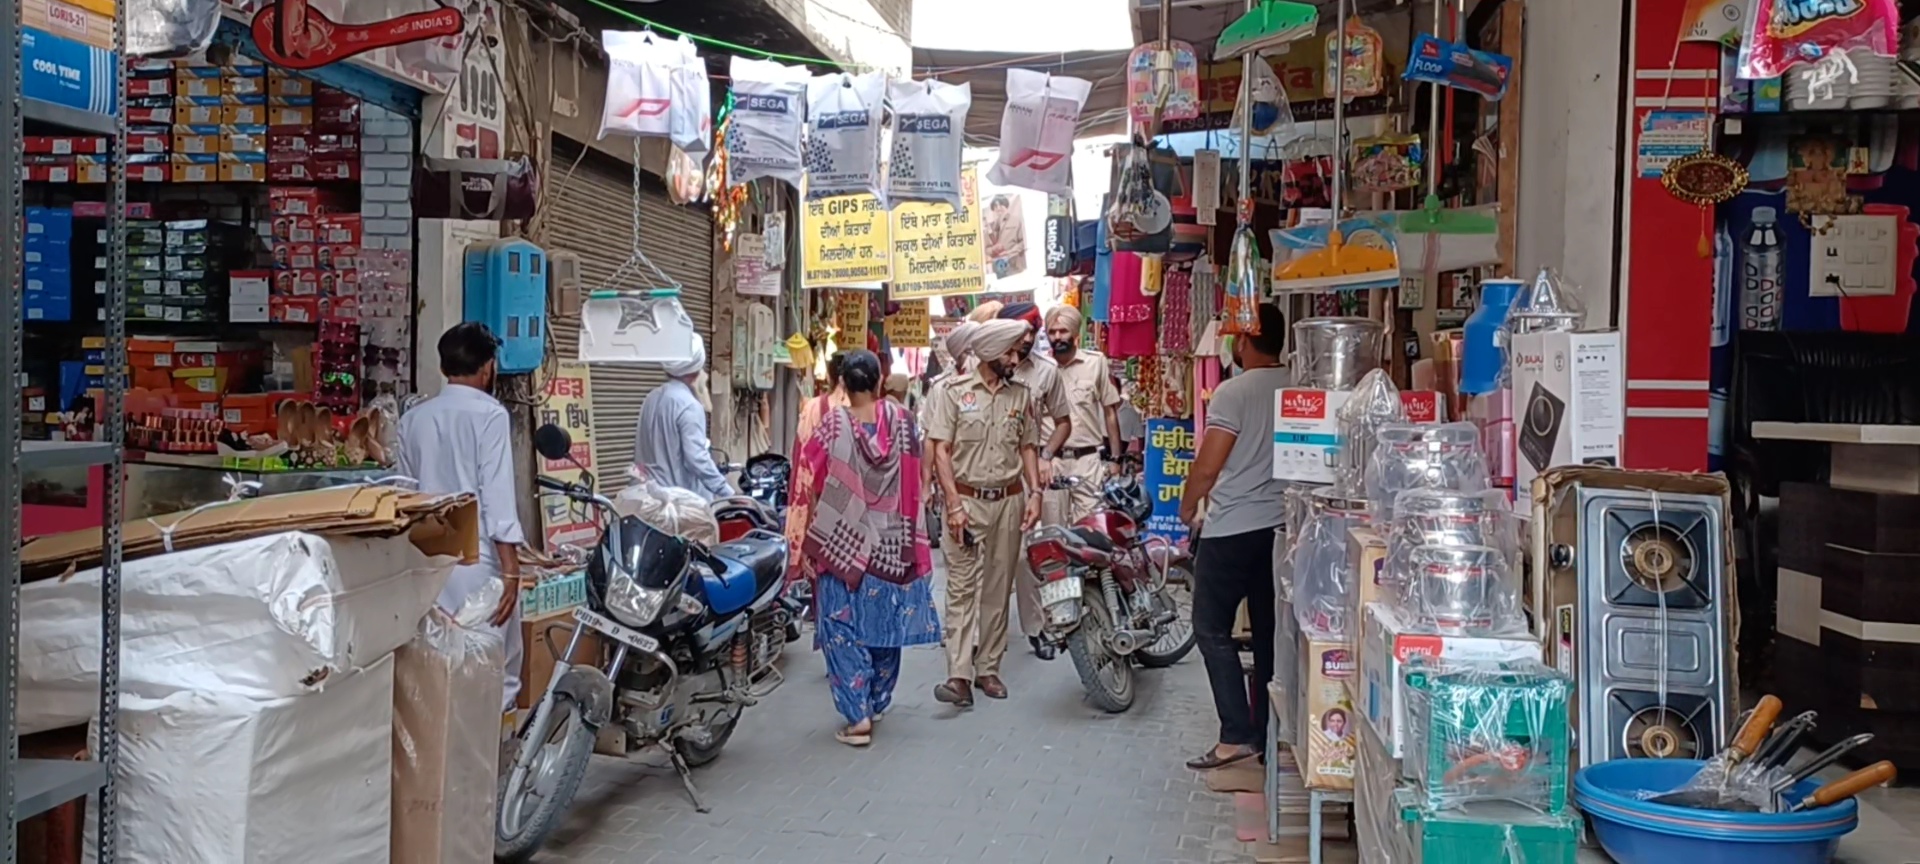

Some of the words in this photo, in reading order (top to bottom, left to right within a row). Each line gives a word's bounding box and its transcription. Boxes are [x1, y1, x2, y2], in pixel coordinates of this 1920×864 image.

[49, 5, 85, 27] LORIS-21
[412, 17, 453, 31] INDIA'S
[33, 59, 57, 75] COOL
[58, 64, 81, 81] TIME
[750, 97, 786, 110] SEGA
[837, 111, 867, 124] SEGA
[917, 118, 949, 130] SEGA
[828, 198, 858, 215] GIPS
[820, 221, 841, 239] ਦੀਆਂ
[844, 219, 872, 237] ਕਿਤਾਬਾਂ
[921, 213, 941, 228] ਮਾਤਾ
[820, 243, 857, 261] ਮਿਲਦੀਆਂ
[859, 245, 873, 258] ਹਨ
[895, 239, 918, 258] ਸਕੂਲ
[921, 233, 943, 250] ਦੀਆਂ
[947, 229, 977, 248] ਕਿਤਾਬਾਂ
[908, 256, 948, 275] ਮਿਲਦੀਆਂ
[951, 257, 966, 271] ਹਨ
[611, 626, 620, 636] D
